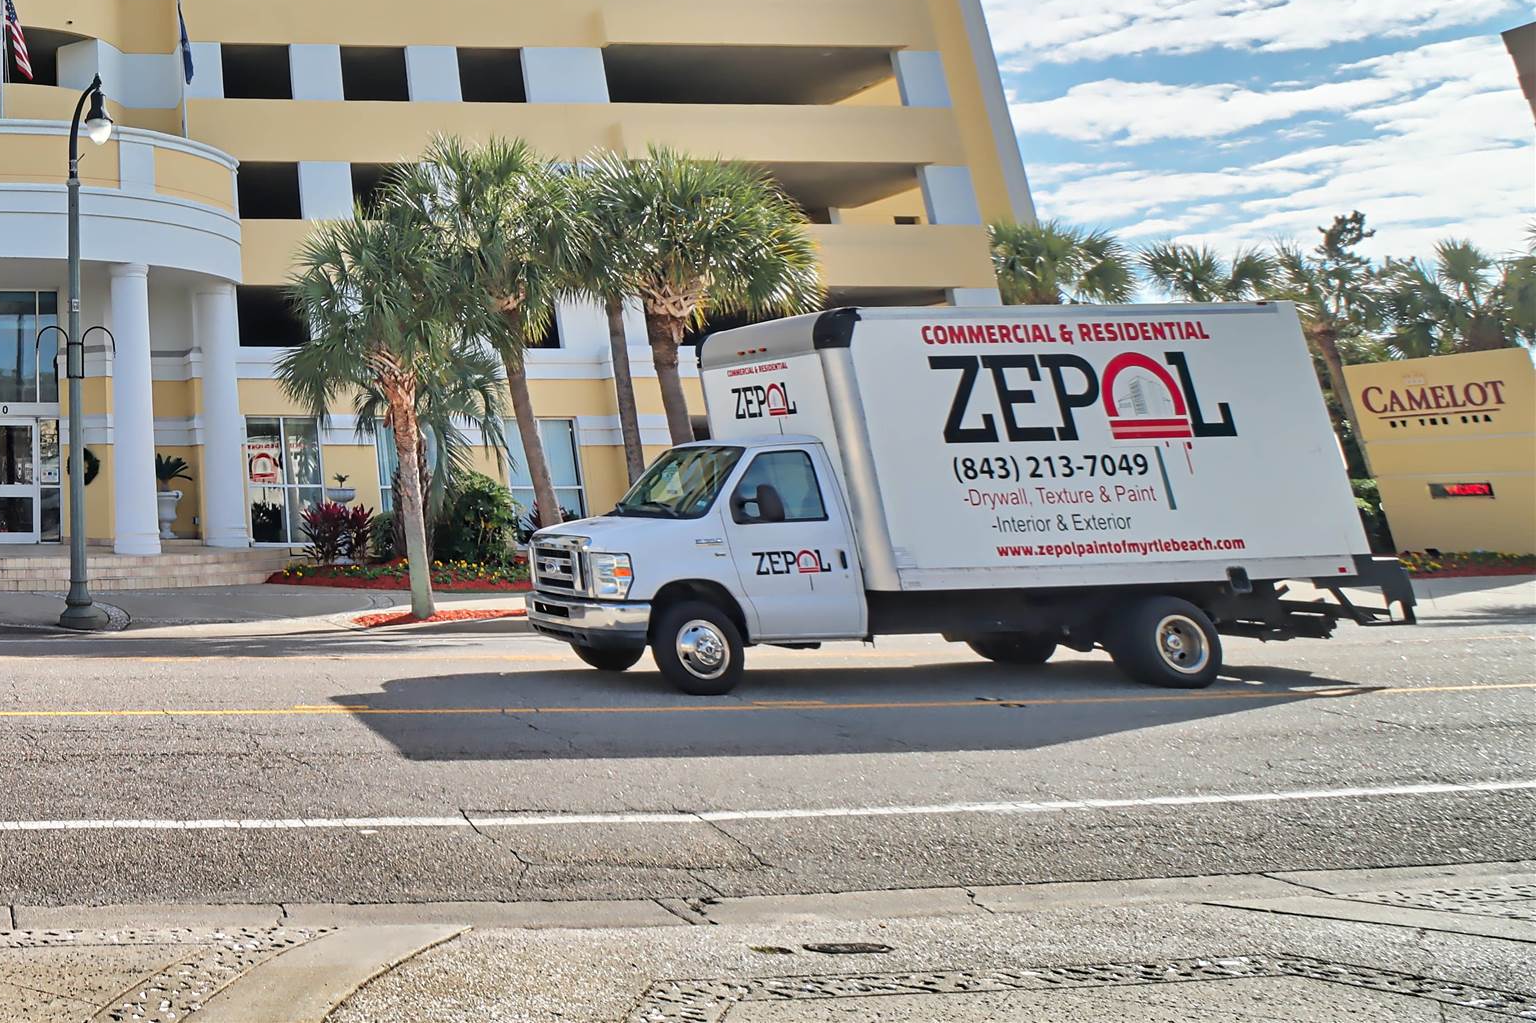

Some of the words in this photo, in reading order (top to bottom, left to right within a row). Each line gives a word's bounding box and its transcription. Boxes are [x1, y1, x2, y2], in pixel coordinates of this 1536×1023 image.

[921, 324, 1057, 345] COMMERCIAL
[1059, 323, 1075, 345] &
[1077, 321, 1210, 342] RESIDENTIAL
[731, 382, 797, 419] ZEPOL
[927, 351, 1238, 444] ZEPOL
[1361, 380, 1505, 414] CAMELOT
[953, 456, 1020, 483] (843)
[1025, 453, 1149, 478] 213-7049
[964, 488, 1033, 510] -Drywall,
[1035, 487, 1094, 505] Texture
[1099, 485, 1111, 503] &
[1114, 484, 1157, 502] Paint
[992, 515, 1051, 533] -Interior
[1057, 514, 1069, 532] &
[1071, 513, 1131, 531] Exterior
[996, 538, 1246, 558] www.zepolpaintofmyrtlebeach.com
[752, 549, 832, 575] ZEPOL
